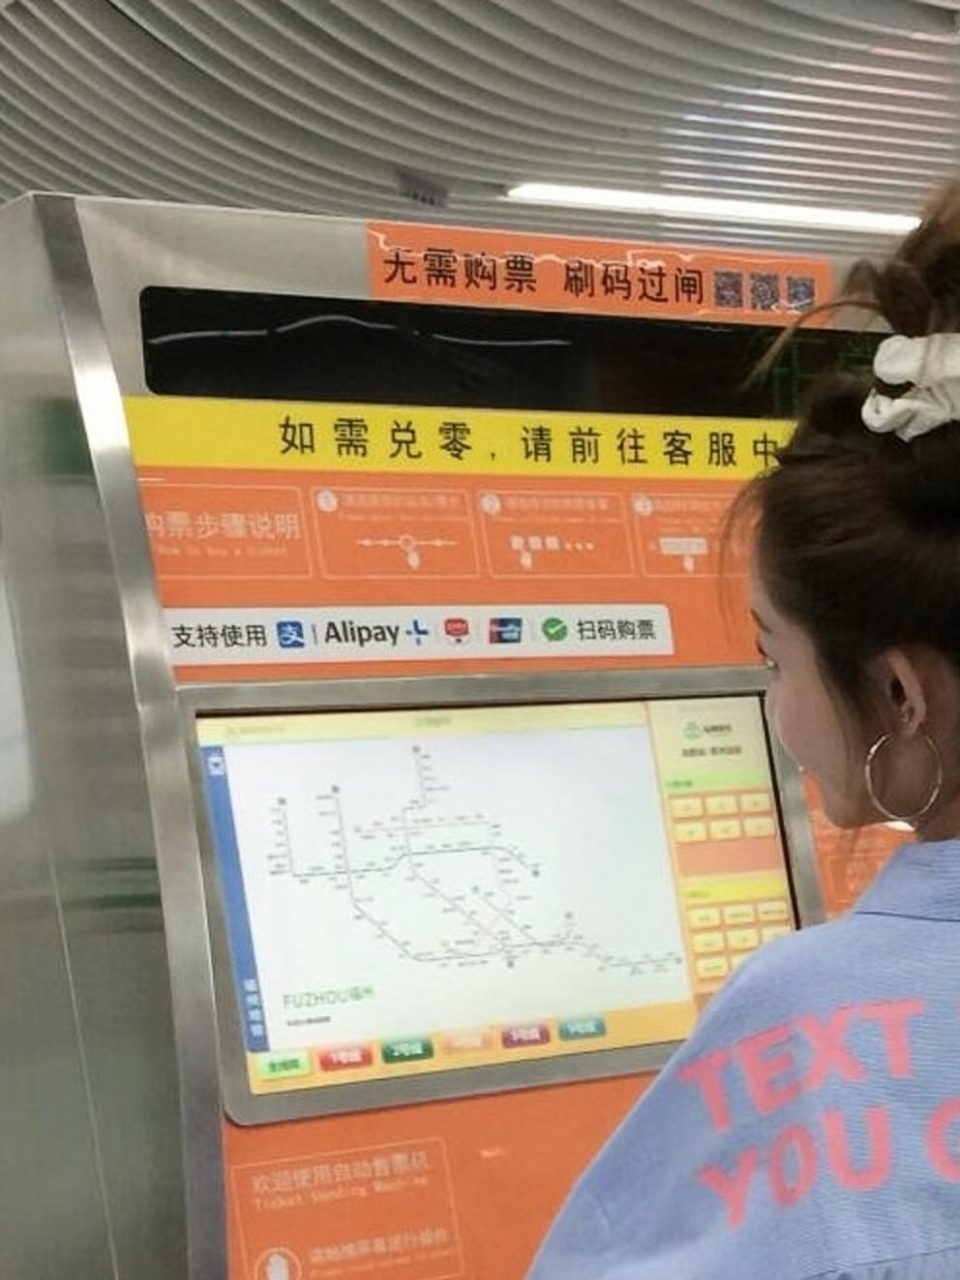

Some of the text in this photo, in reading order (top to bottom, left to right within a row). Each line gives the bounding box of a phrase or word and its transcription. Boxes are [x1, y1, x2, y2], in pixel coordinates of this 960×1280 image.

[383, 246, 705, 305] 无需购票 刷码过闸
[171, 624, 268, 649] 支持使用
[324, 620, 400, 647] Alipay
[576, 619, 657, 641] 扫码购票
[677, 998, 926, 1133] TEXT
[696, 1103, 894, 1230] YOU
